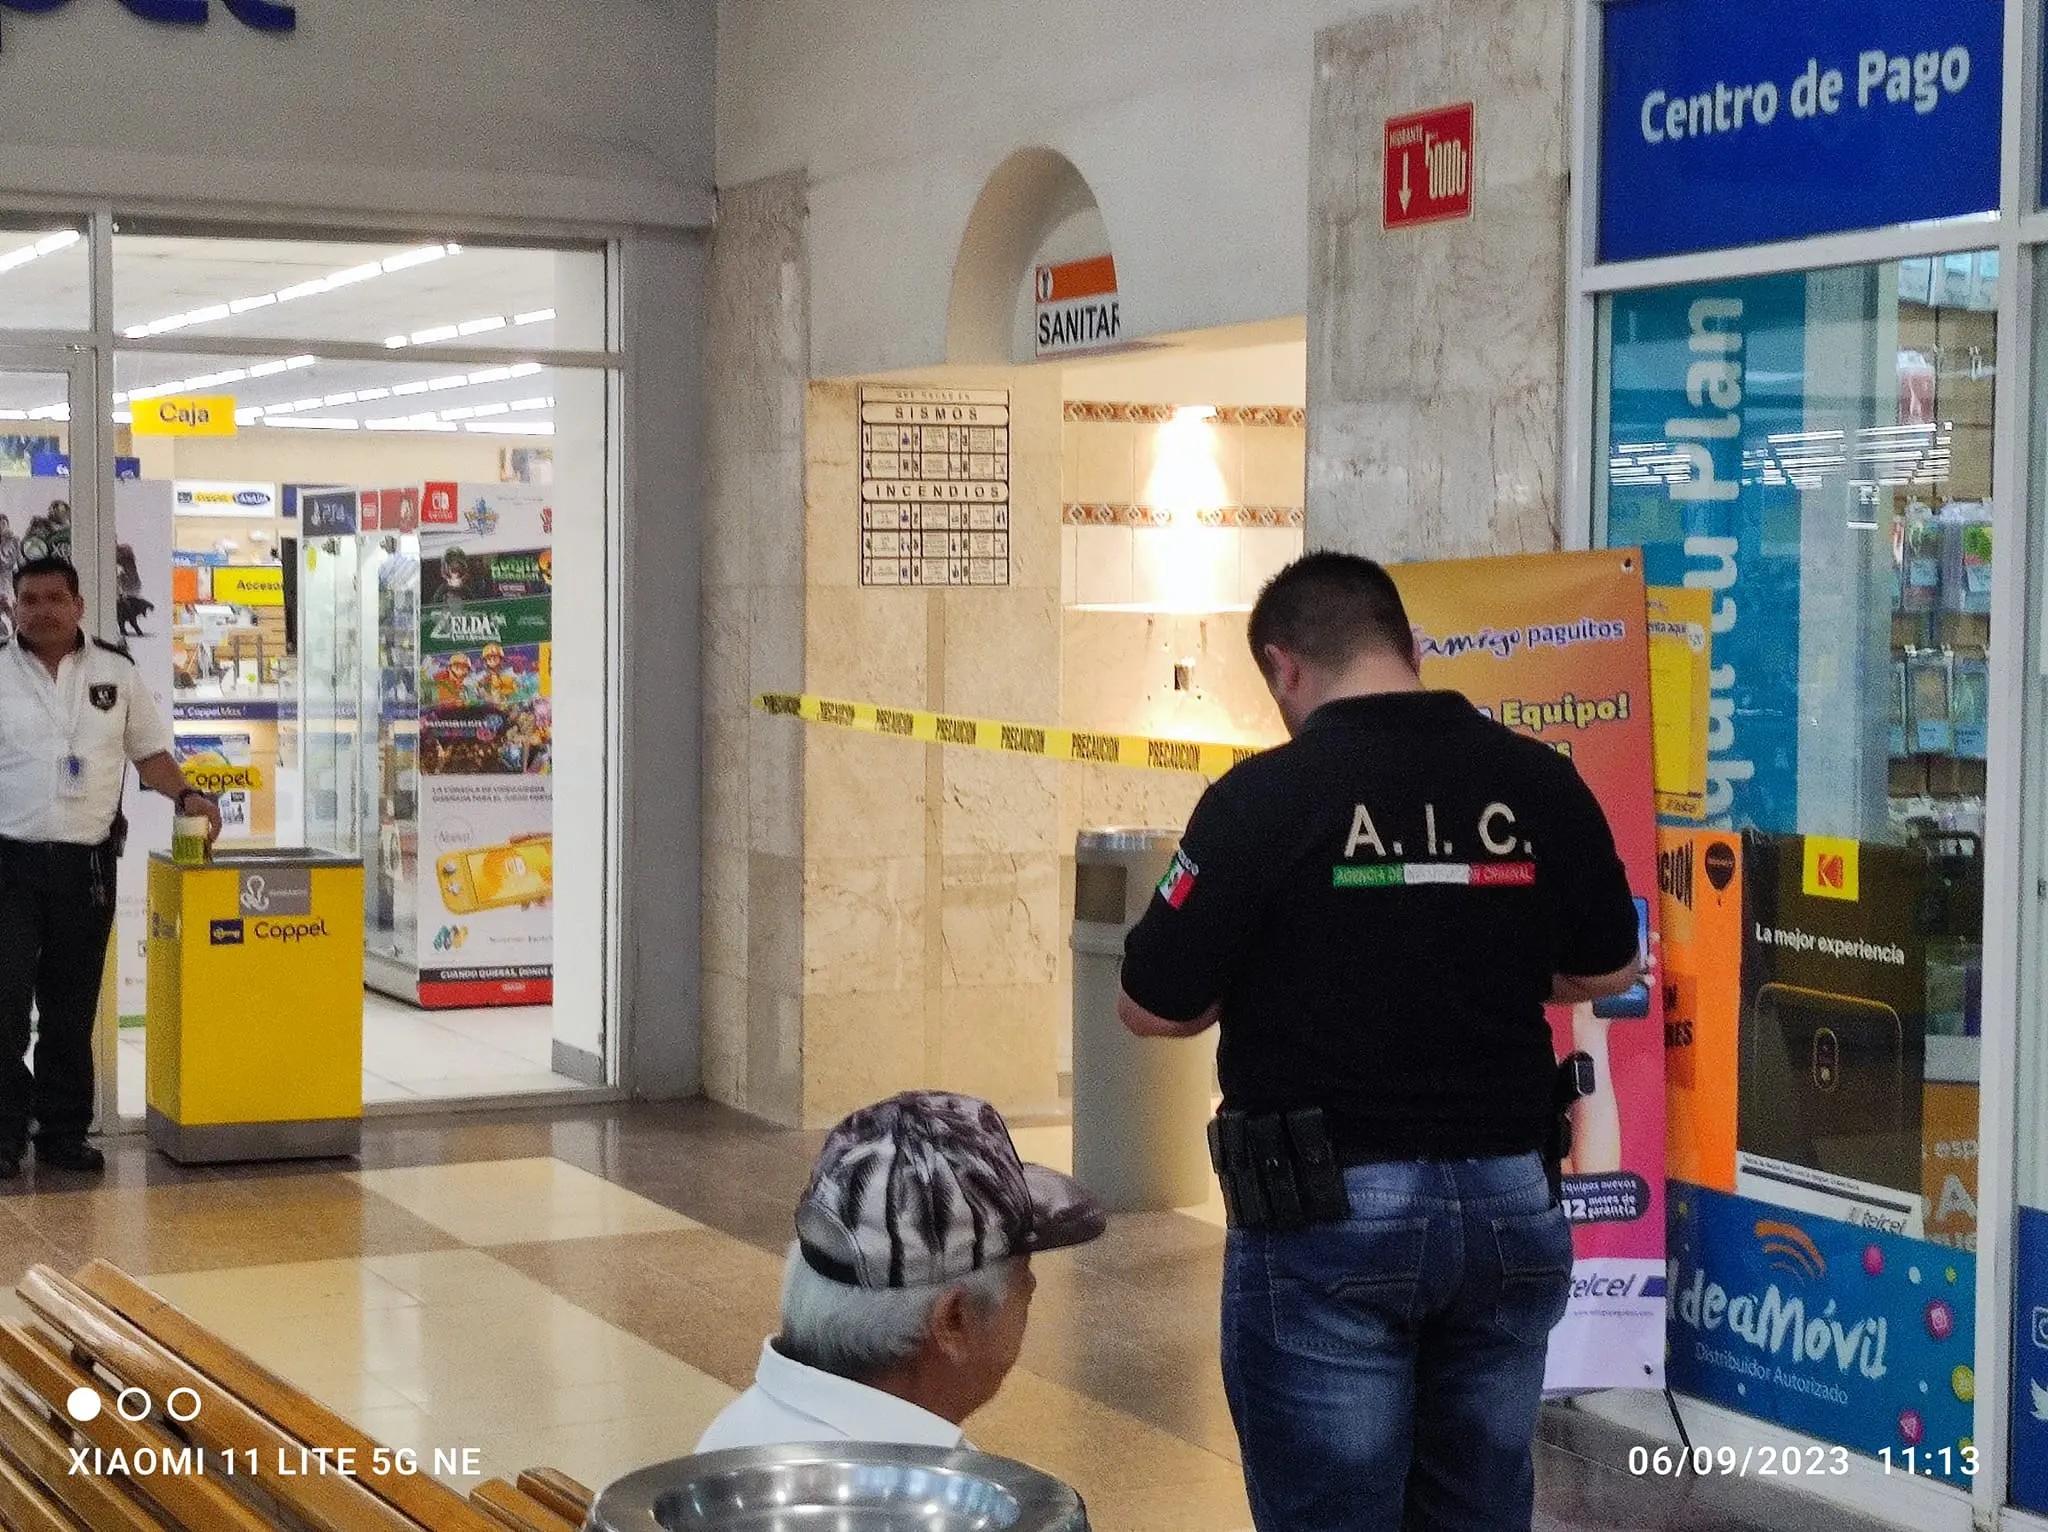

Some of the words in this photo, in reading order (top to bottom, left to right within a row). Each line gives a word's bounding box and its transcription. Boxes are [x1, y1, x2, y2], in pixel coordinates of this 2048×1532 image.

[1641, 81, 1778, 144] Centro
[1790, 58, 1844, 119] de
[1857, 46, 1971, 115] Pago
[1038, 300, 1121, 347] SANITAR
[159, 401, 210, 427] Caja
[894, 406, 979, 421] SISMOS
[1664, 297, 1743, 500] Plan
[876, 485, 1000, 498] INCENDIOS
[1526, 620, 1625, 647] paguitos
[1502, 692, 1631, 733] Equipo!
[1000, 725, 1046, 755] PRECAUCION
[1071, 732, 1121, 763] PRECAUCION
[1147, 740, 1201, 773] PRECAUCION
[254, 917, 328, 943] Coppel
[1754, 922, 1773, 943] La
[1773, 928, 1815, 957] mejor
[1817, 935, 1906, 966] experiencia
[1561, 1197, 1588, 1220] 12
[1696, 1342, 1773, 1382] Distribuidor
[1773, 1364, 1850, 1406] Autorizado
